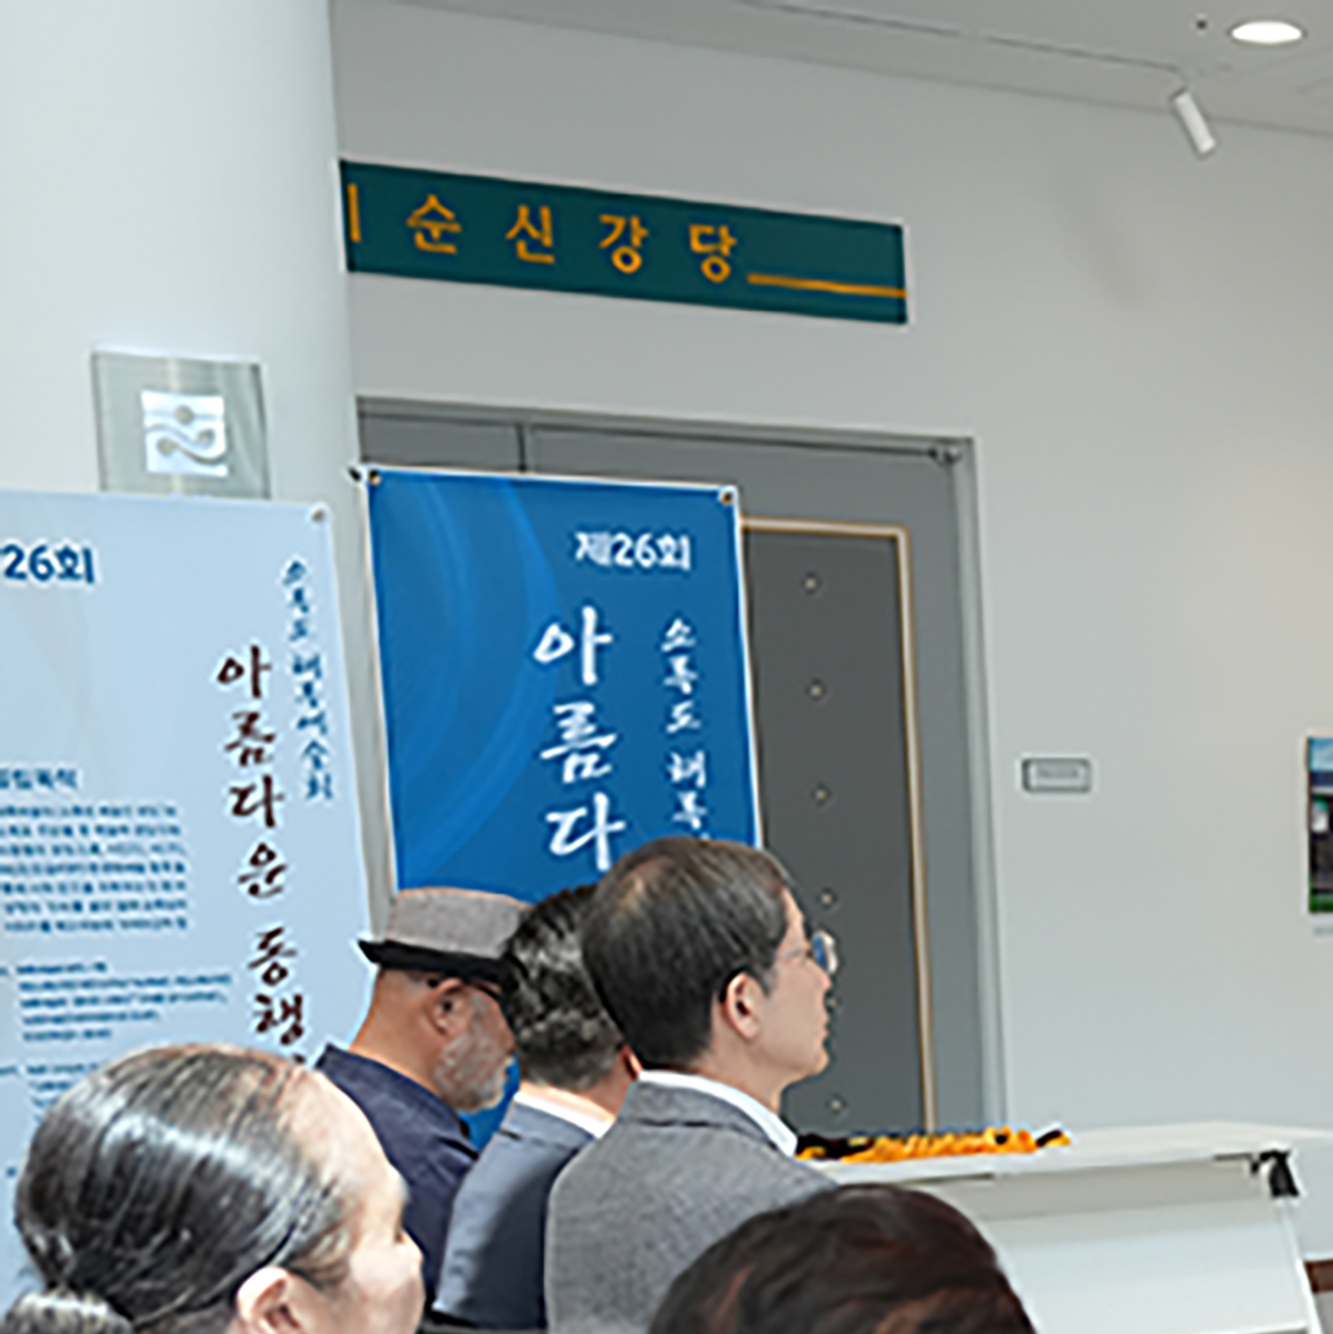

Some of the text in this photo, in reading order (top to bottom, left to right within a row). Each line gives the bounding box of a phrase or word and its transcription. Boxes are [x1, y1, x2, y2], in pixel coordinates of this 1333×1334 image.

[575, 531, 692, 570] 제26회
[662, 619, 710, 840] 소록도 해록
[216, 645, 305, 1064] 아름다운 동행
